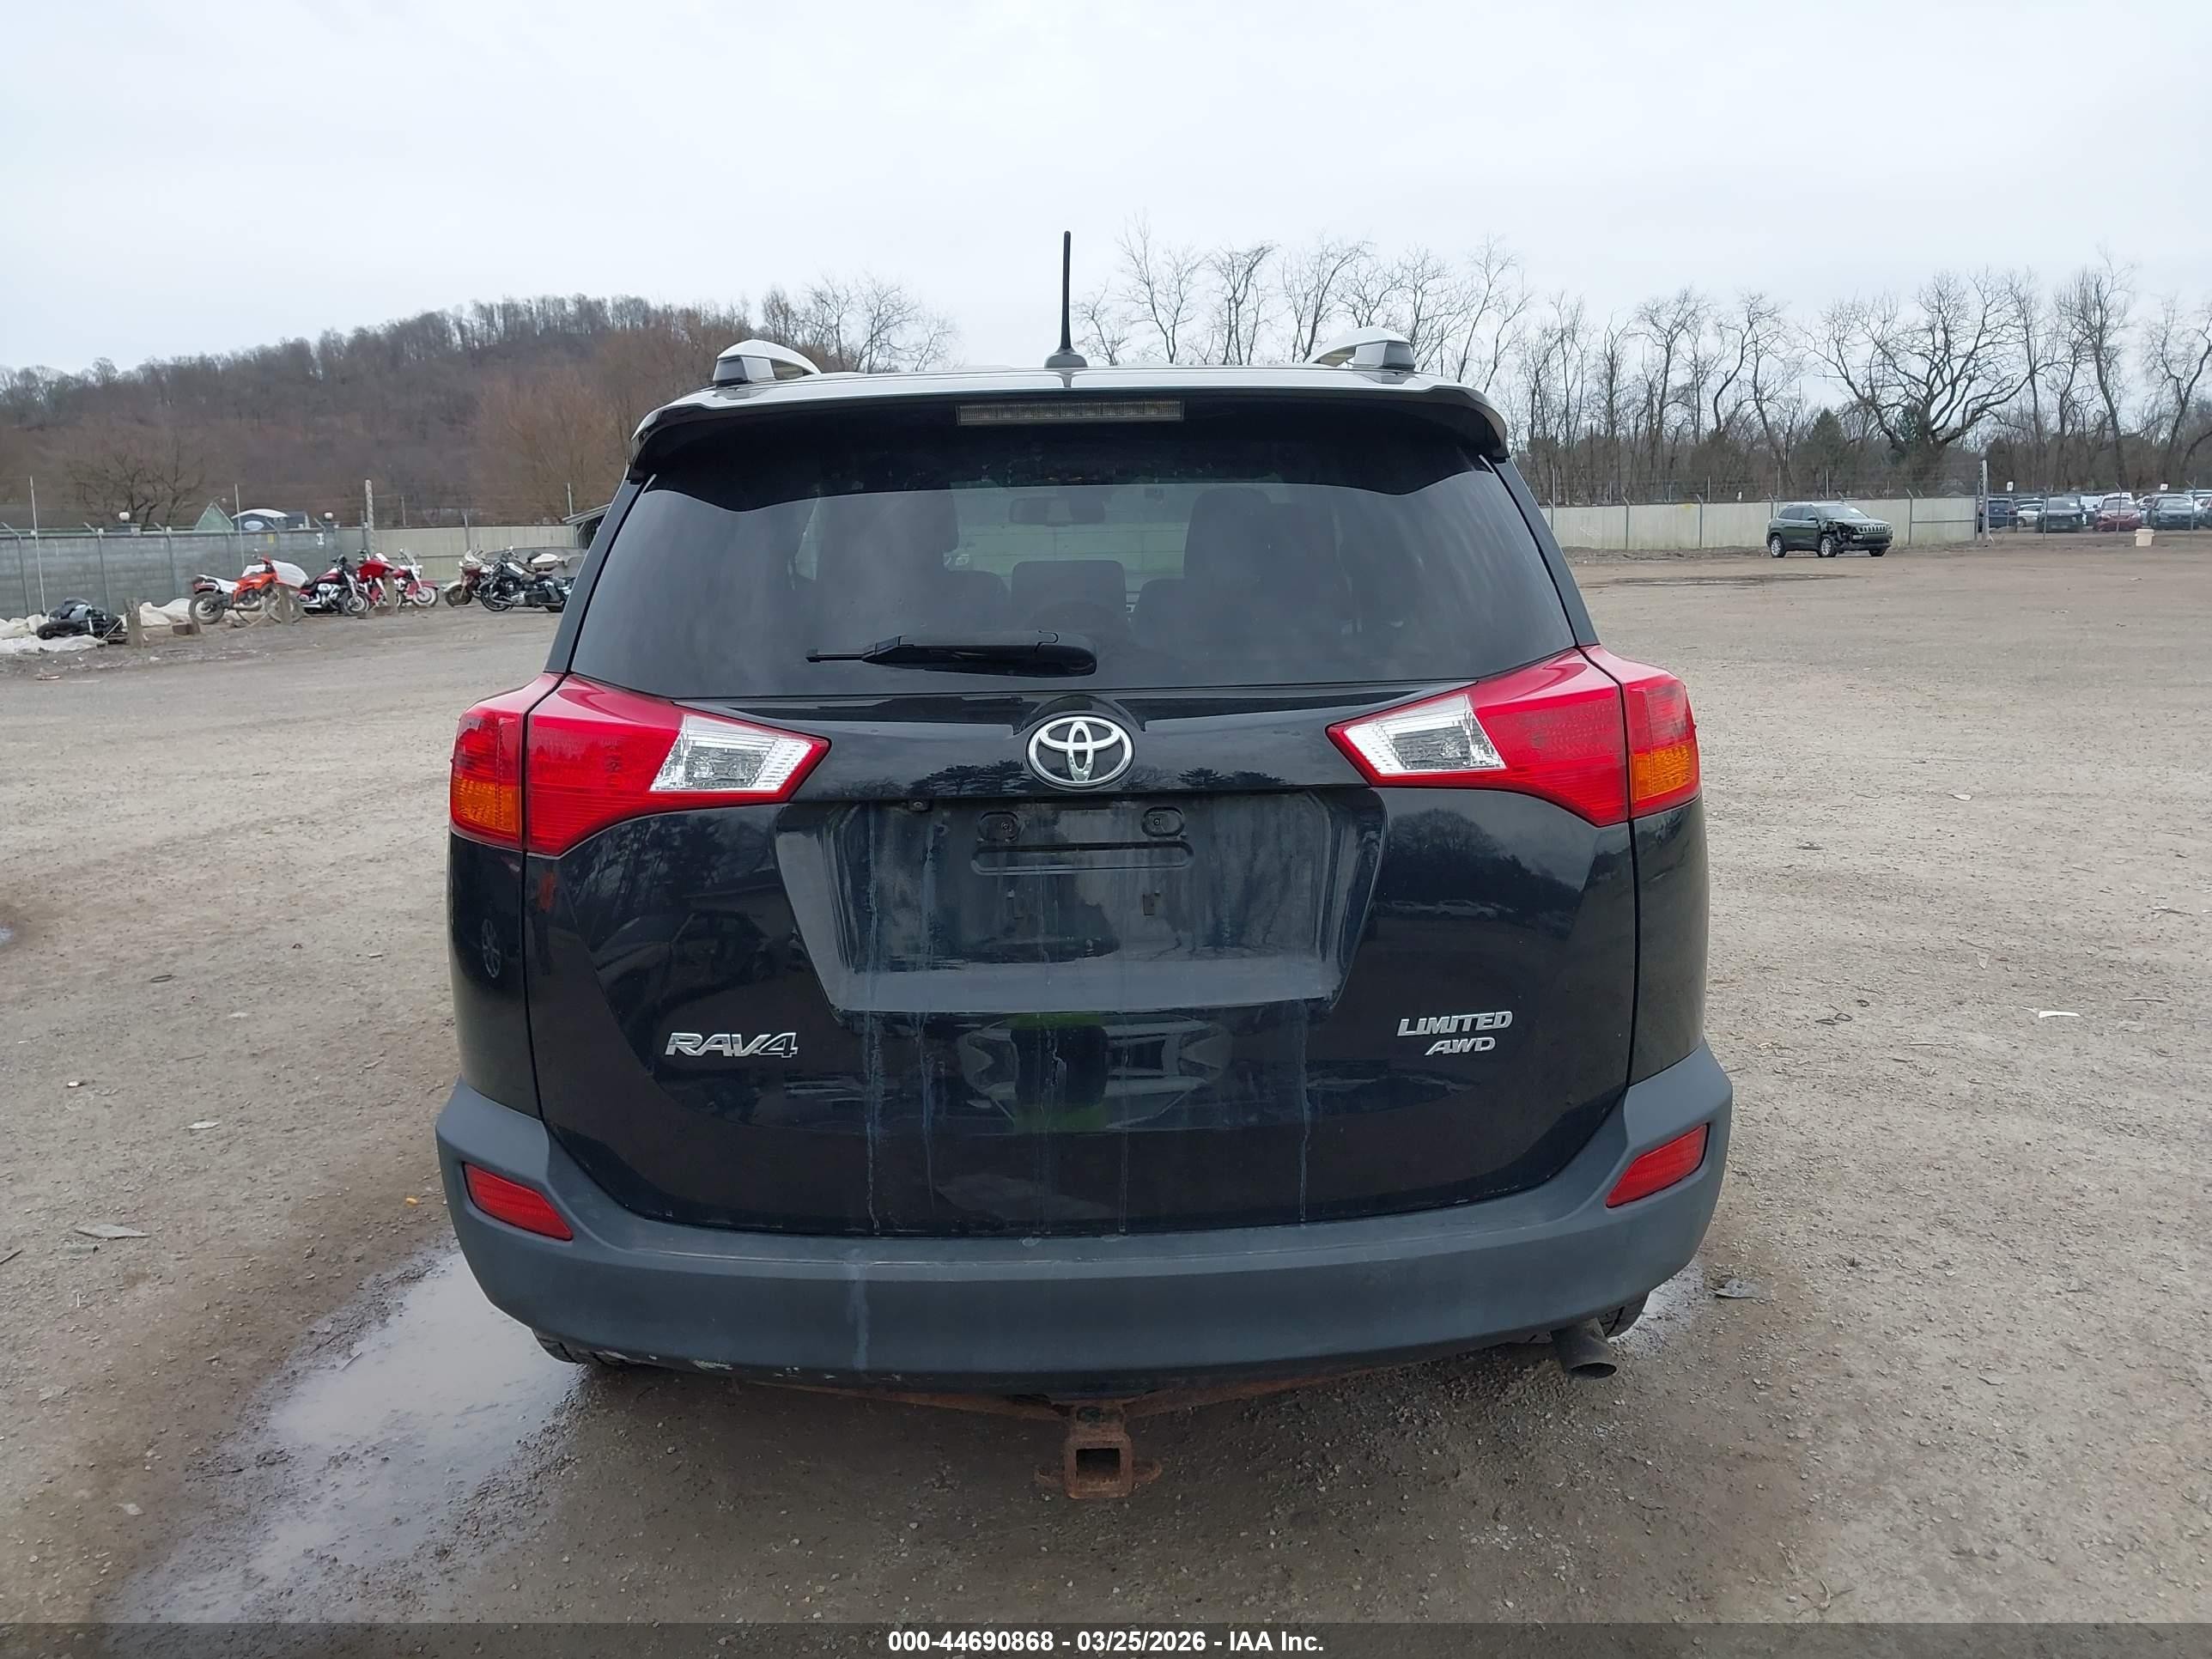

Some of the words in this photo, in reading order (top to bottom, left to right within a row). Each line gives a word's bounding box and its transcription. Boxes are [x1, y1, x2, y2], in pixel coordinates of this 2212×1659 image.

[1397, 1011, 1513, 1036] LIMITED
[665, 1032, 799, 1058] RAV4
[1424, 1036, 1496, 1056] AWD
